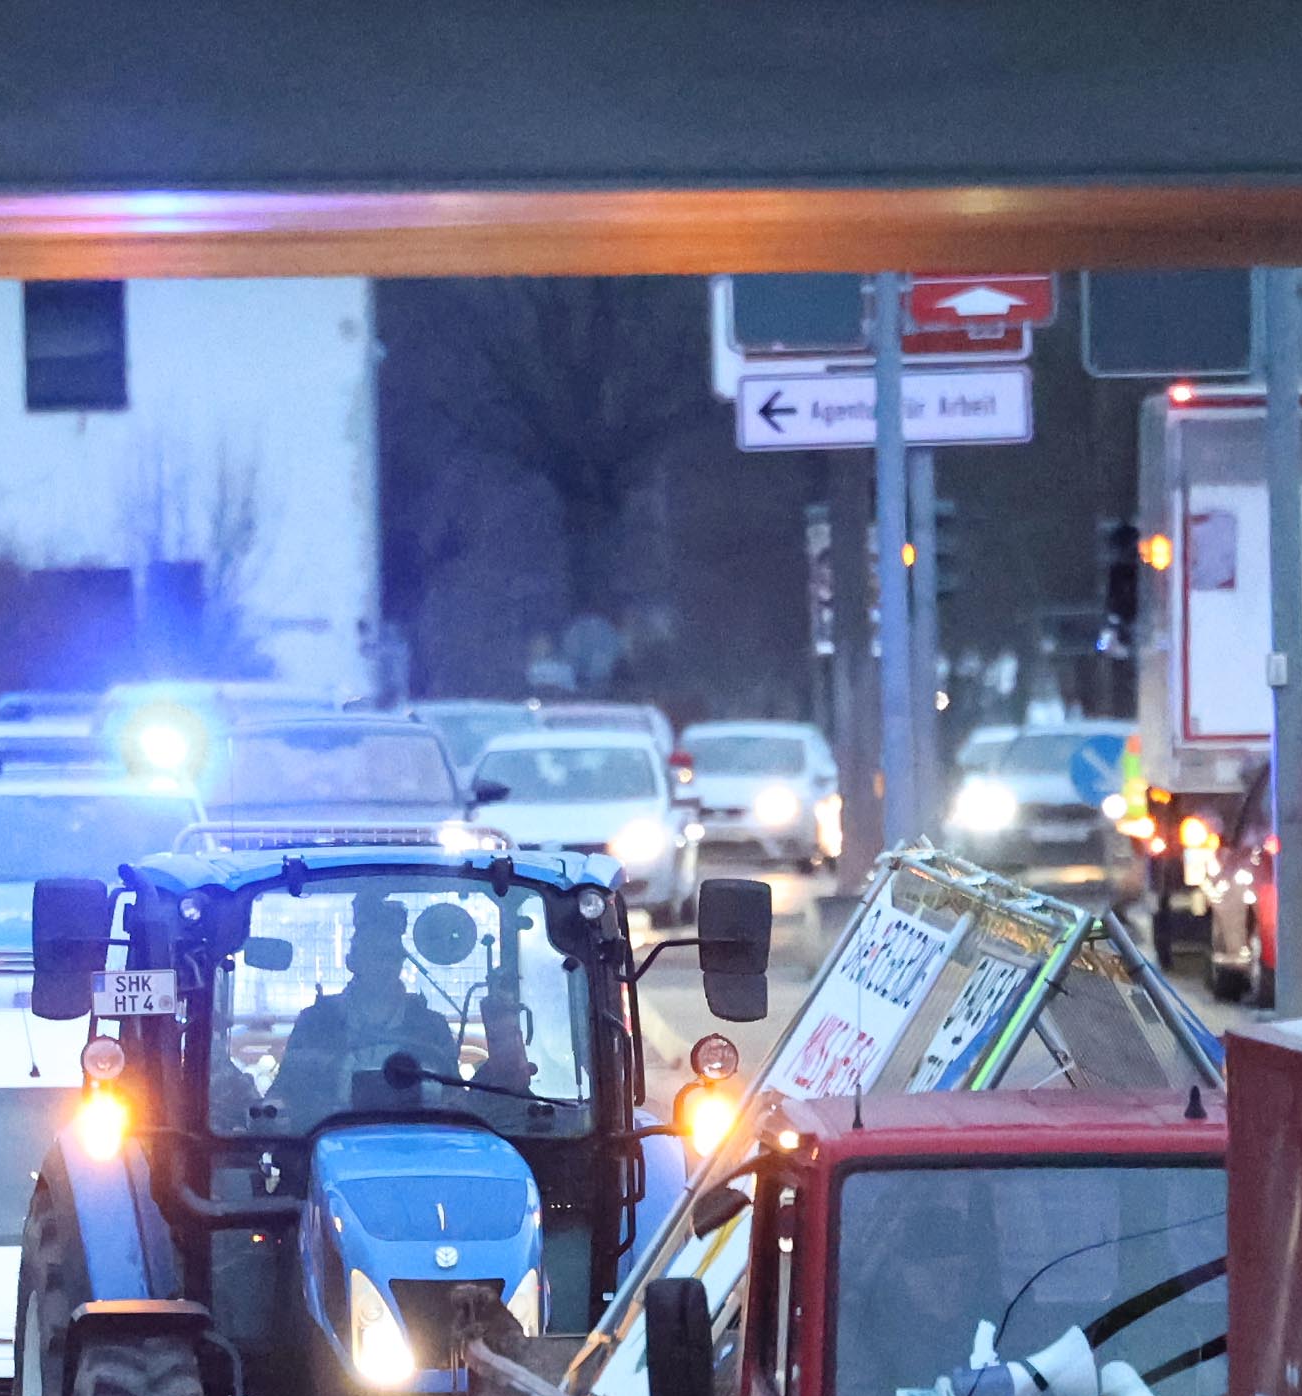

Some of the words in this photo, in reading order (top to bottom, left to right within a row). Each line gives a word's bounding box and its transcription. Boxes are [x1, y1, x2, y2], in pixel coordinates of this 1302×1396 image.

[115, 975, 152, 993] SHK
[114, 995, 139, 1013] HT
[142, 995, 154, 1012] 4
